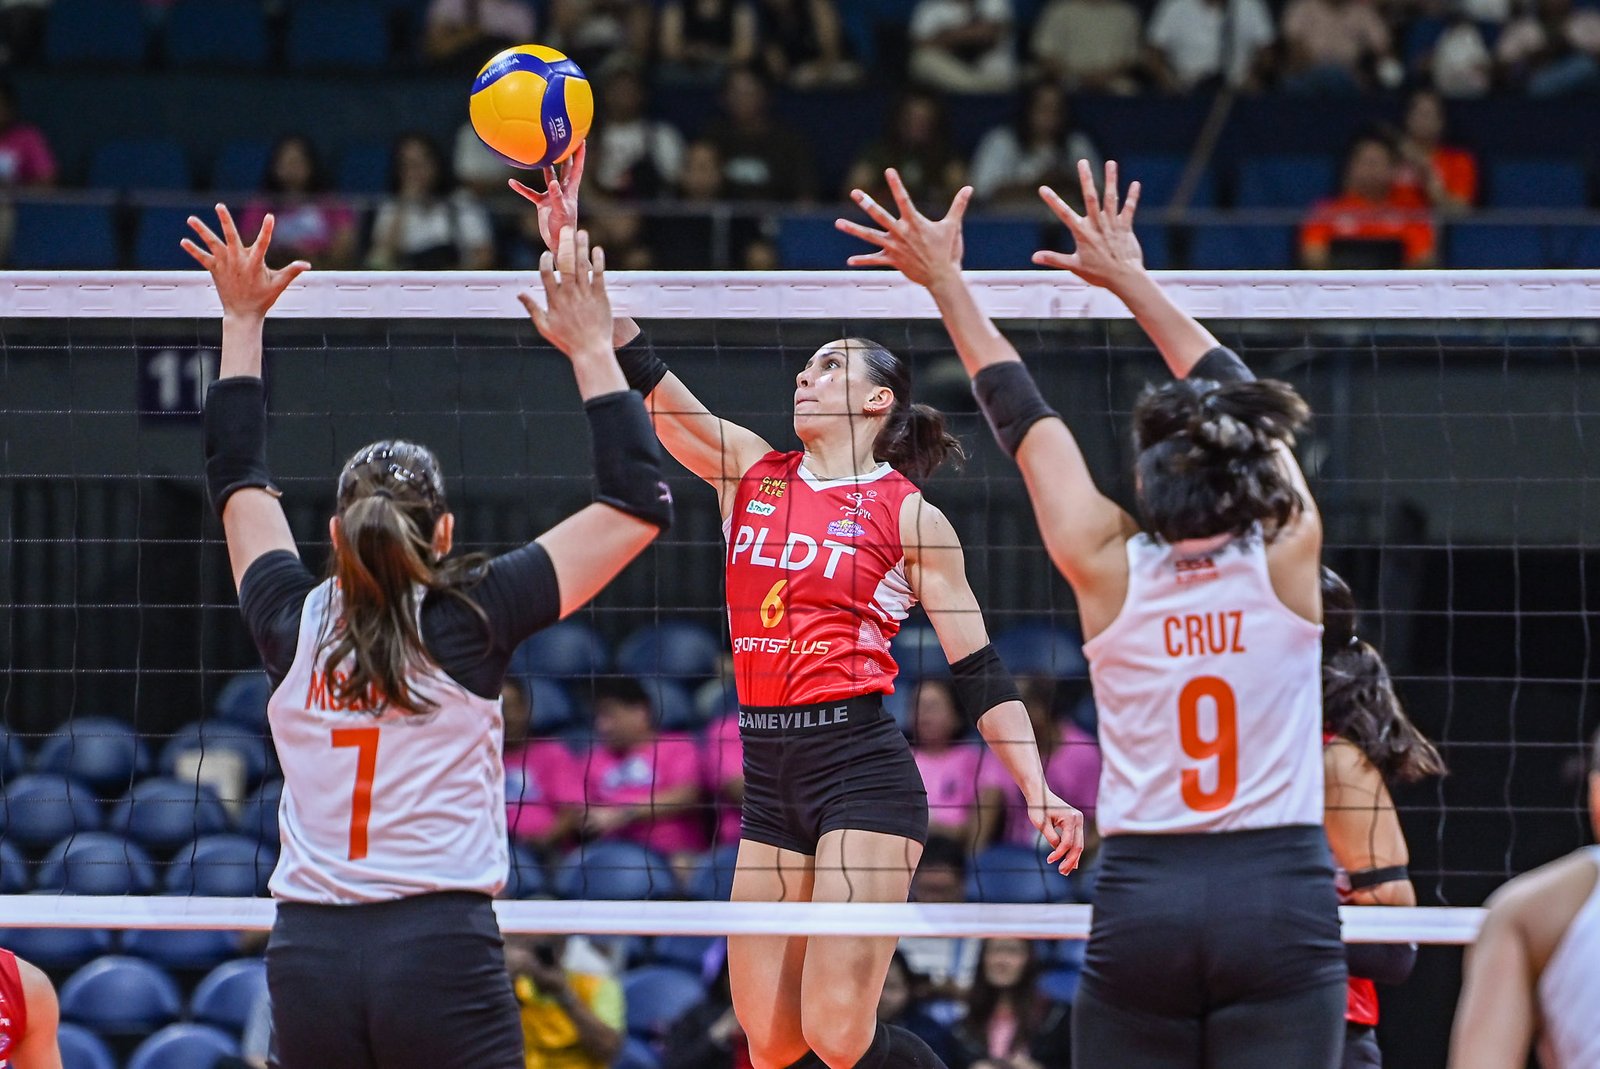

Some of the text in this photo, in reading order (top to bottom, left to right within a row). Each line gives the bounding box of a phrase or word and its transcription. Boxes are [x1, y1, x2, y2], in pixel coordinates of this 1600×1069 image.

[555, 116, 567, 139] FIVB
[732, 525, 857, 580] PLDT
[760, 579, 788, 629] 6
[1164, 609, 1246, 658] CRUZ
[738, 705, 849, 730] GAMEVILLE
[1178, 673, 1238, 812] 9
[331, 727, 381, 861] 7
